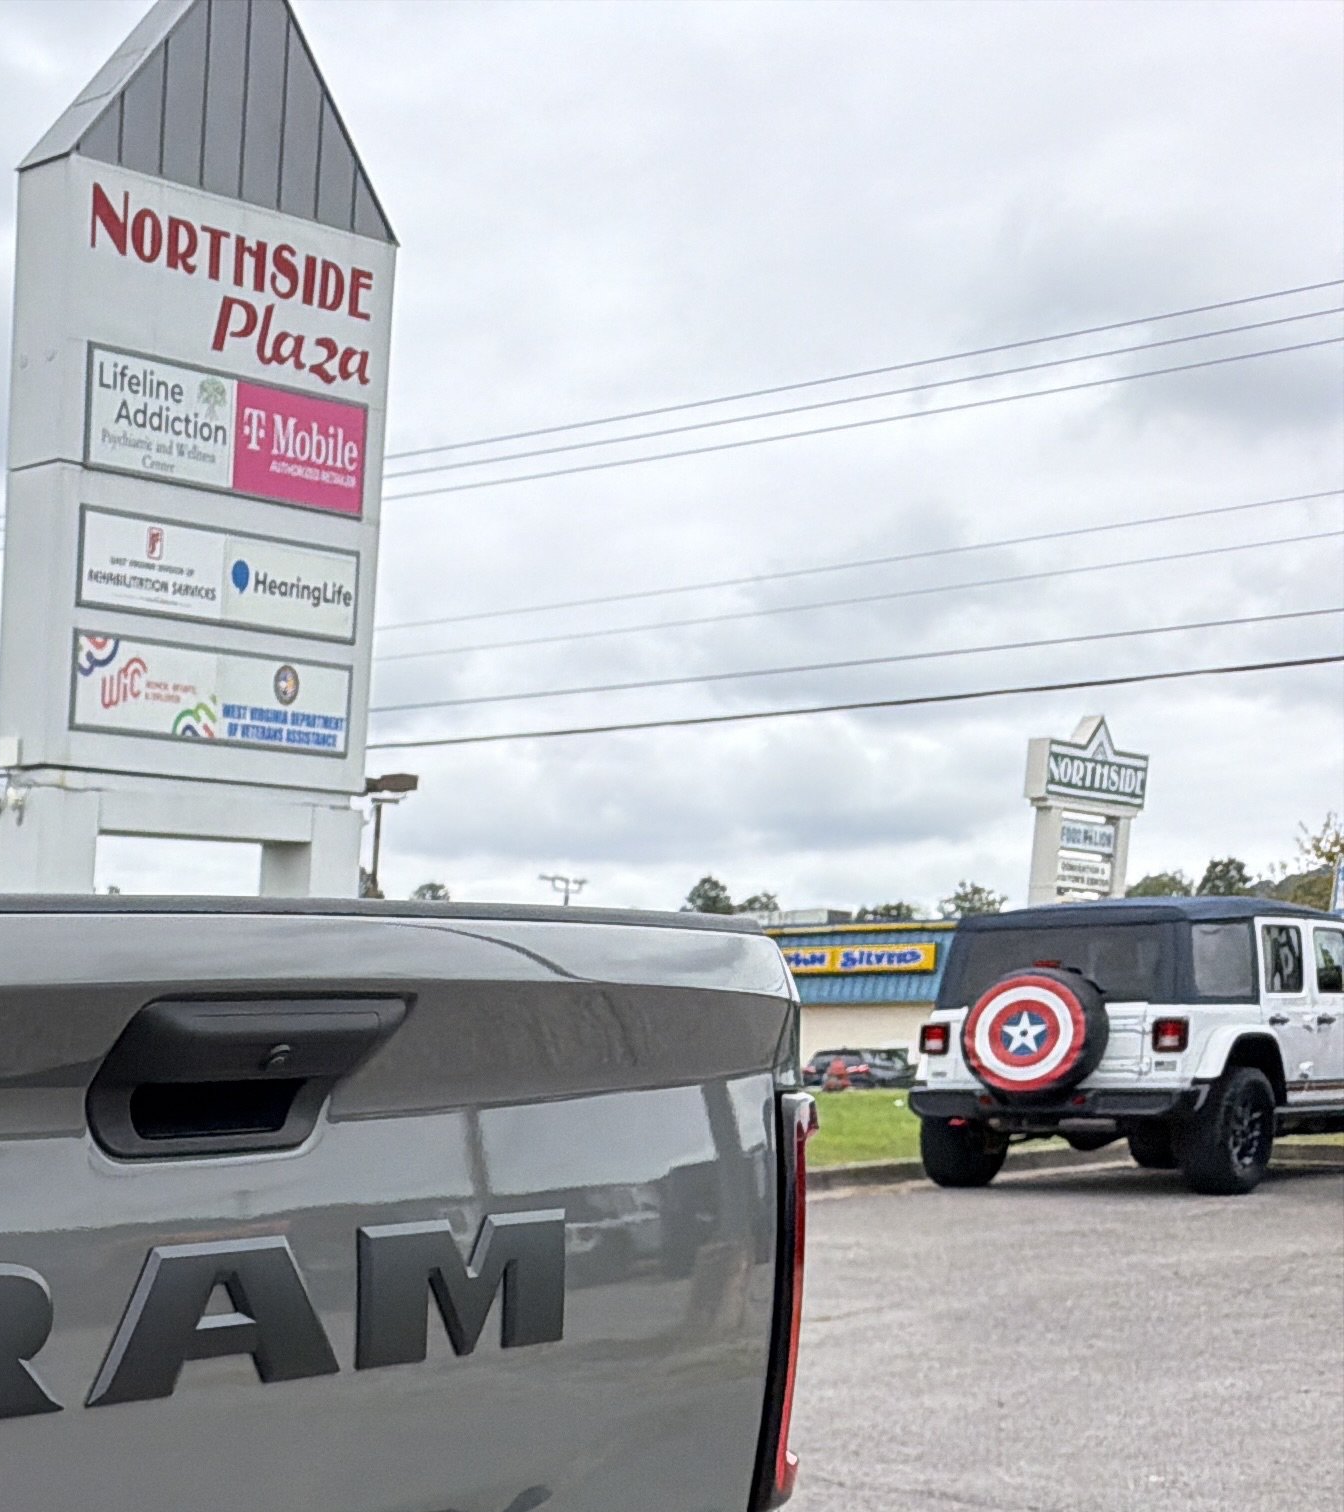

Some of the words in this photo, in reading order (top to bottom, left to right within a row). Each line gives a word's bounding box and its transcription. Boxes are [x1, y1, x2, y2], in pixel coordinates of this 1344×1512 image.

[91, 181, 374, 321] NORTHSIDE
[212, 295, 371, 385] Plaza
[98, 361, 184, 403] Lifeline
[114, 398, 227, 445] Addiction
[243, 407, 266, 451] T
[271, 412, 358, 471] Mobile
[156, 440, 174, 456] and
[171, 581, 217, 601] SERVICES
[254, 570, 353, 608] HearingLife
[1049, 754, 1146, 795] NORTHSIDE
